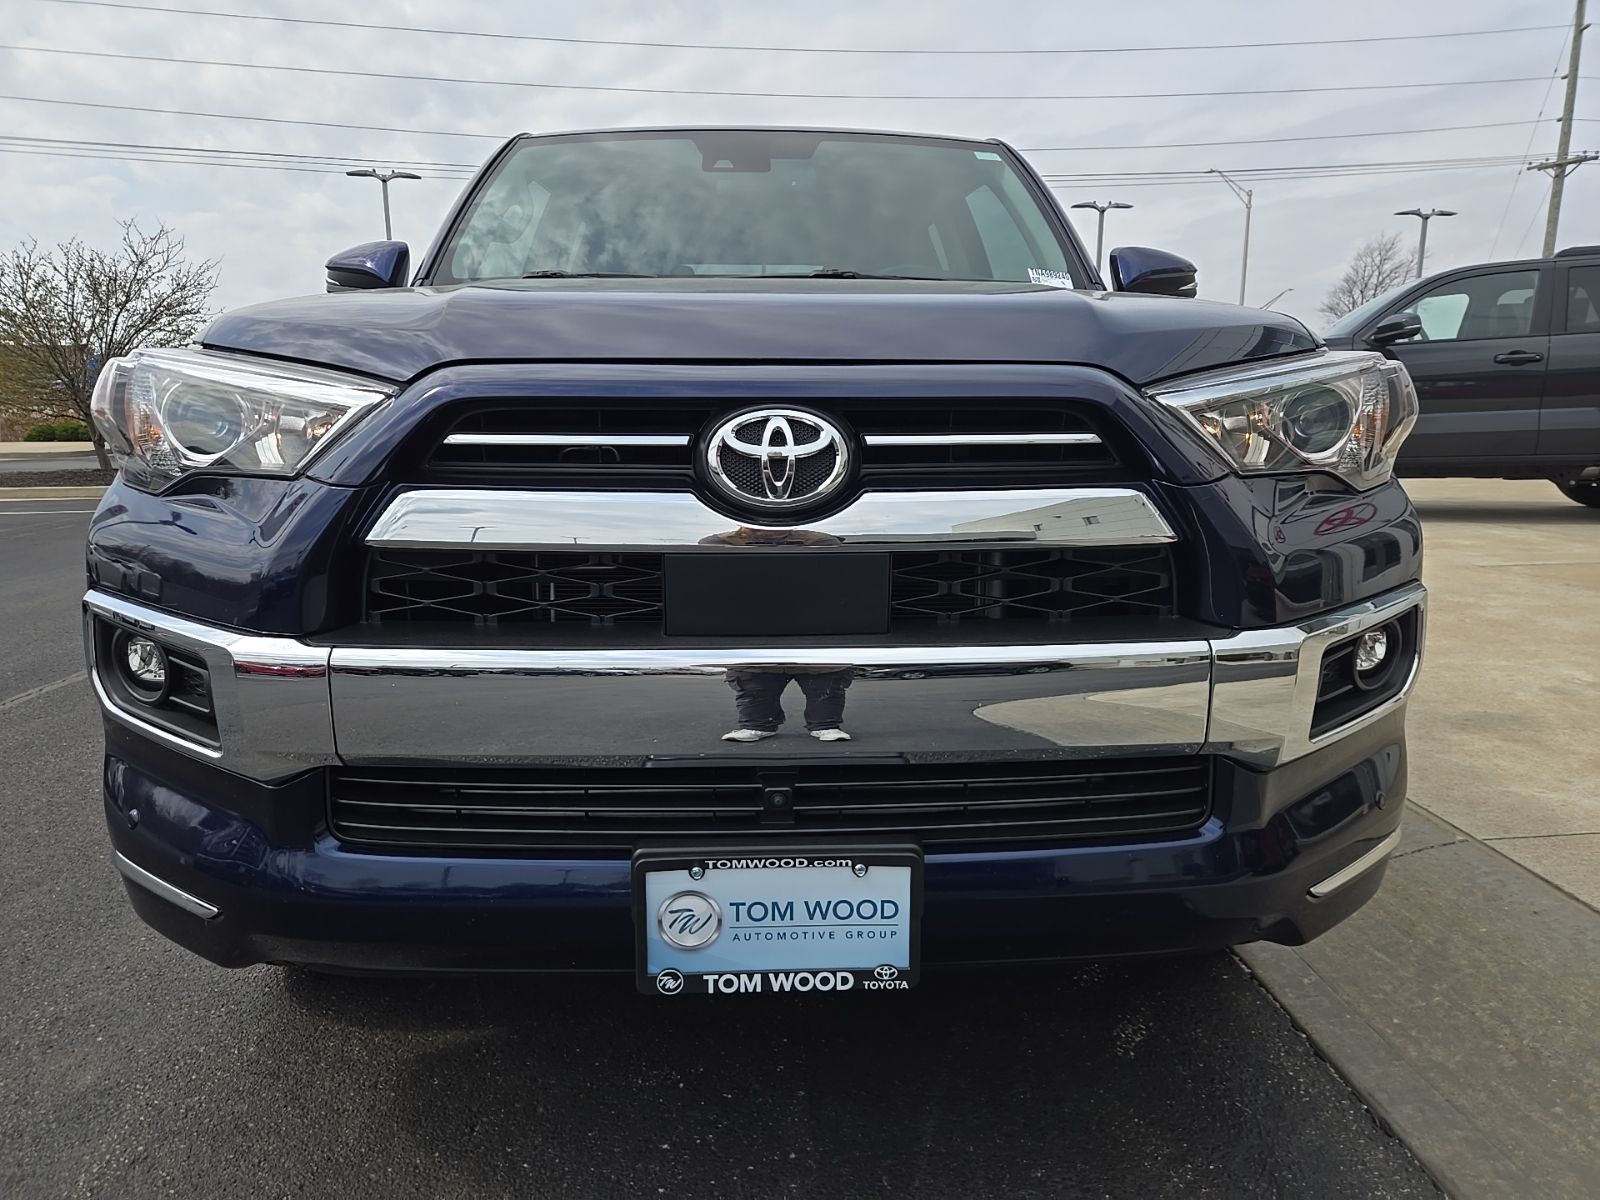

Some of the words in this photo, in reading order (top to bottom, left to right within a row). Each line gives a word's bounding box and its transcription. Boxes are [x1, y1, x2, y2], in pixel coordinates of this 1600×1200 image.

[705, 858, 852, 869] TOMWOOD.com
[729, 901, 794, 922] TOM
[804, 899, 899, 920] WOOD
[732, 931, 836, 942] AUTOMOTIVE
[845, 930, 898, 939] GROUP
[703, 973, 762, 994] TOM
[768, 971, 855, 992] WOOD
[862, 980, 909, 990] TOYOTA
